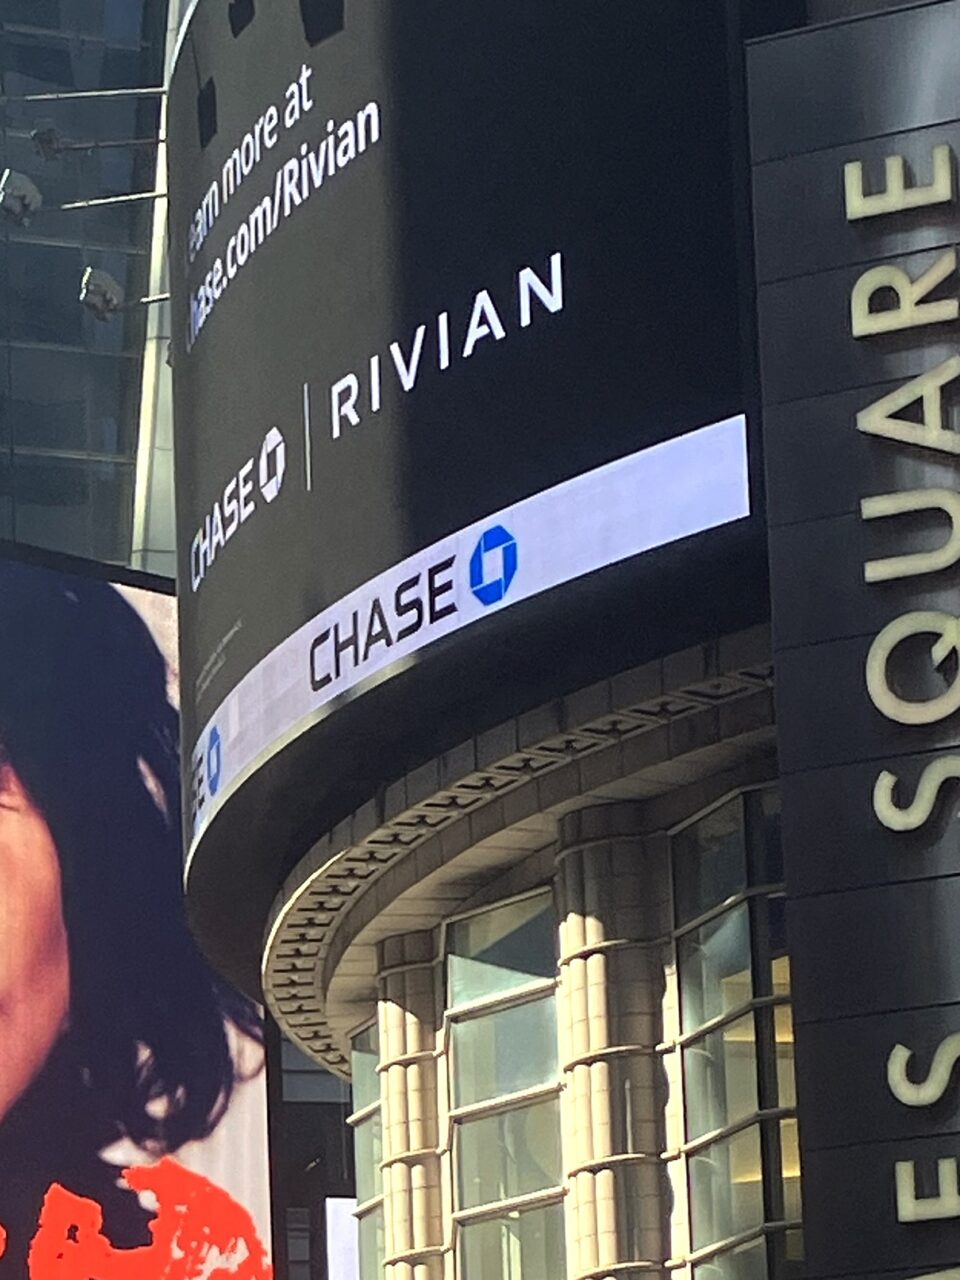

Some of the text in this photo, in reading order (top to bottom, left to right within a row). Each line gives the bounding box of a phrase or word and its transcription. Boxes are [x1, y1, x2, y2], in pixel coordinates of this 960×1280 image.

[189, 63, 313, 263] earn more at
[190, 251, 565, 592] CHASE RIVIAN
[844, 142, 960, 833] SQUARE
[308, 554, 458, 693] CHASE
